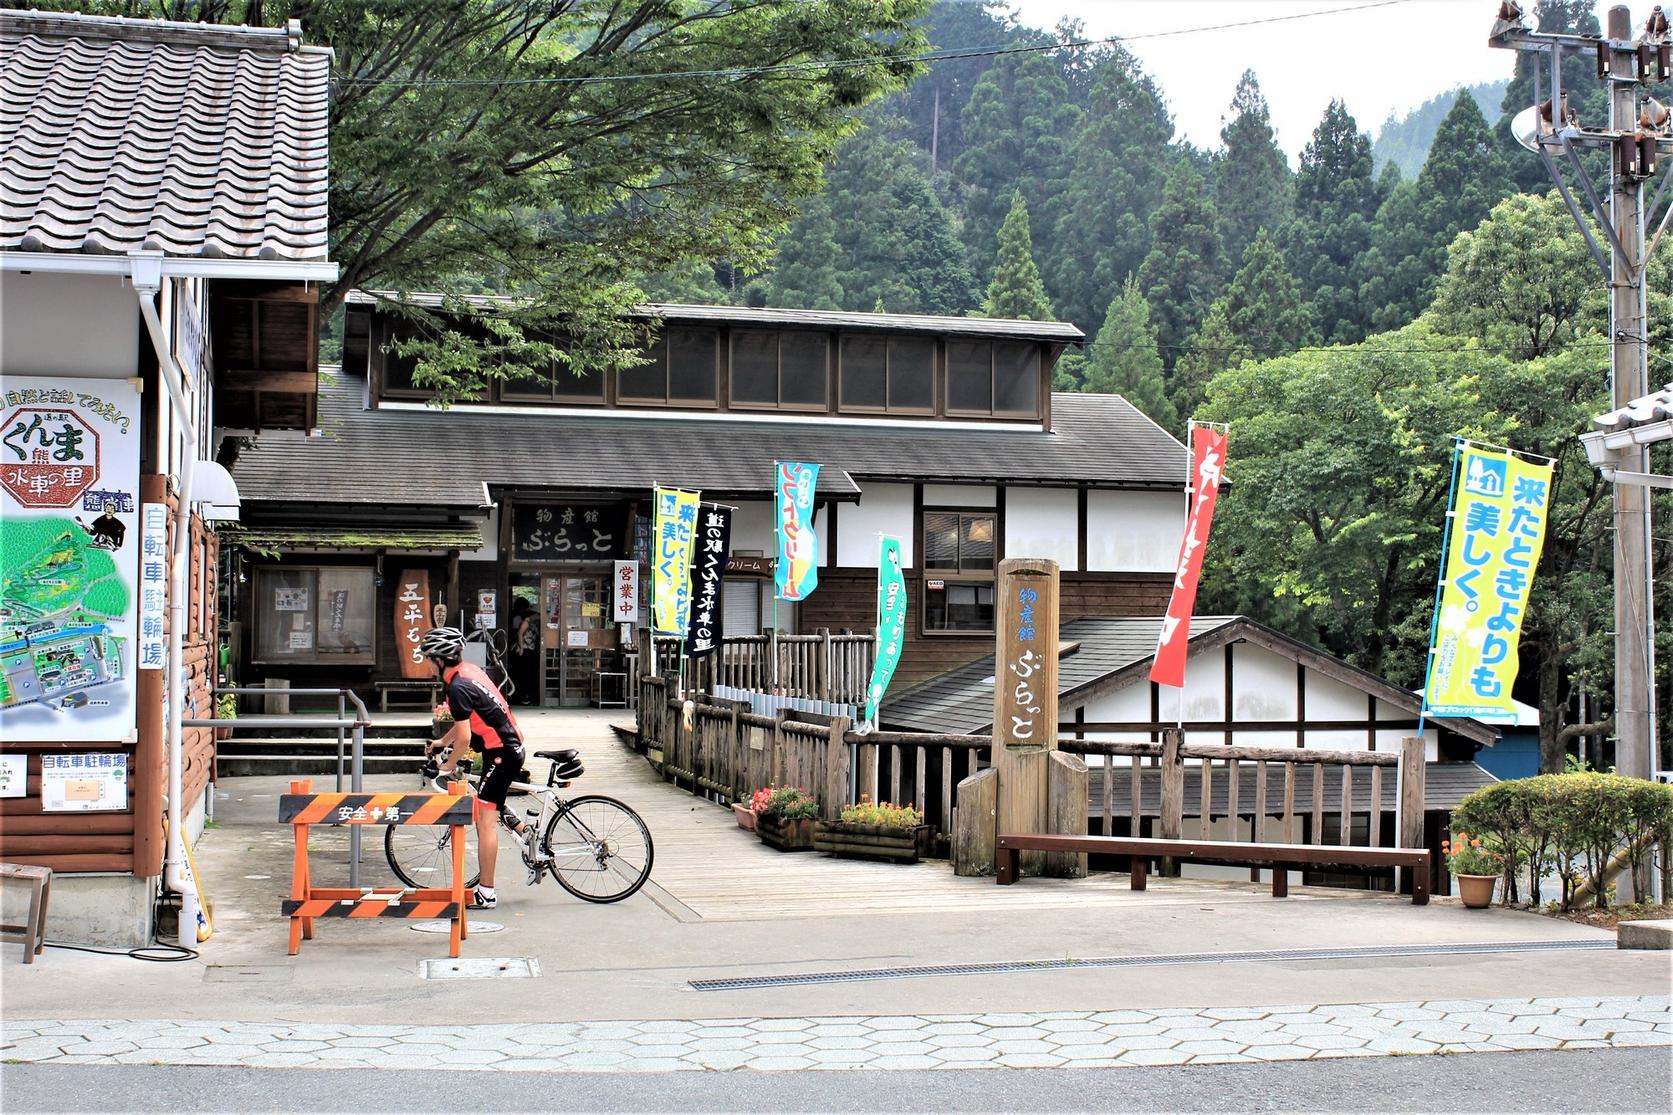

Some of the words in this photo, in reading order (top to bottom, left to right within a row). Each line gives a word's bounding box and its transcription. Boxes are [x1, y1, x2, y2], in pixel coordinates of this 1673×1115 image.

[3, 414, 84, 461] くんま
[32, 447, 50, 464] 熊
[8, 467, 83, 497] 水車の里
[536, 507, 599, 525] 物産館
[523, 528, 612, 552] ぶらっと
[1455, 502, 1500, 612] 美しく。
[142, 507, 164, 665] 自転車駐輪場
[728, 560, 761, 570] クリーム
[1470, 476, 1547, 698] 来たときよりも
[619, 566, 634, 617] 営業中
[1018, 587, 1038, 641] 物産館
[400, 583, 425, 664] 五平もち
[1010, 650, 1041, 739] ぶらっと
[43, 755, 126, 768] 自転車駐輪場
[339, 805, 368, 820] 安全
[385, 806, 414, 821] 第一
